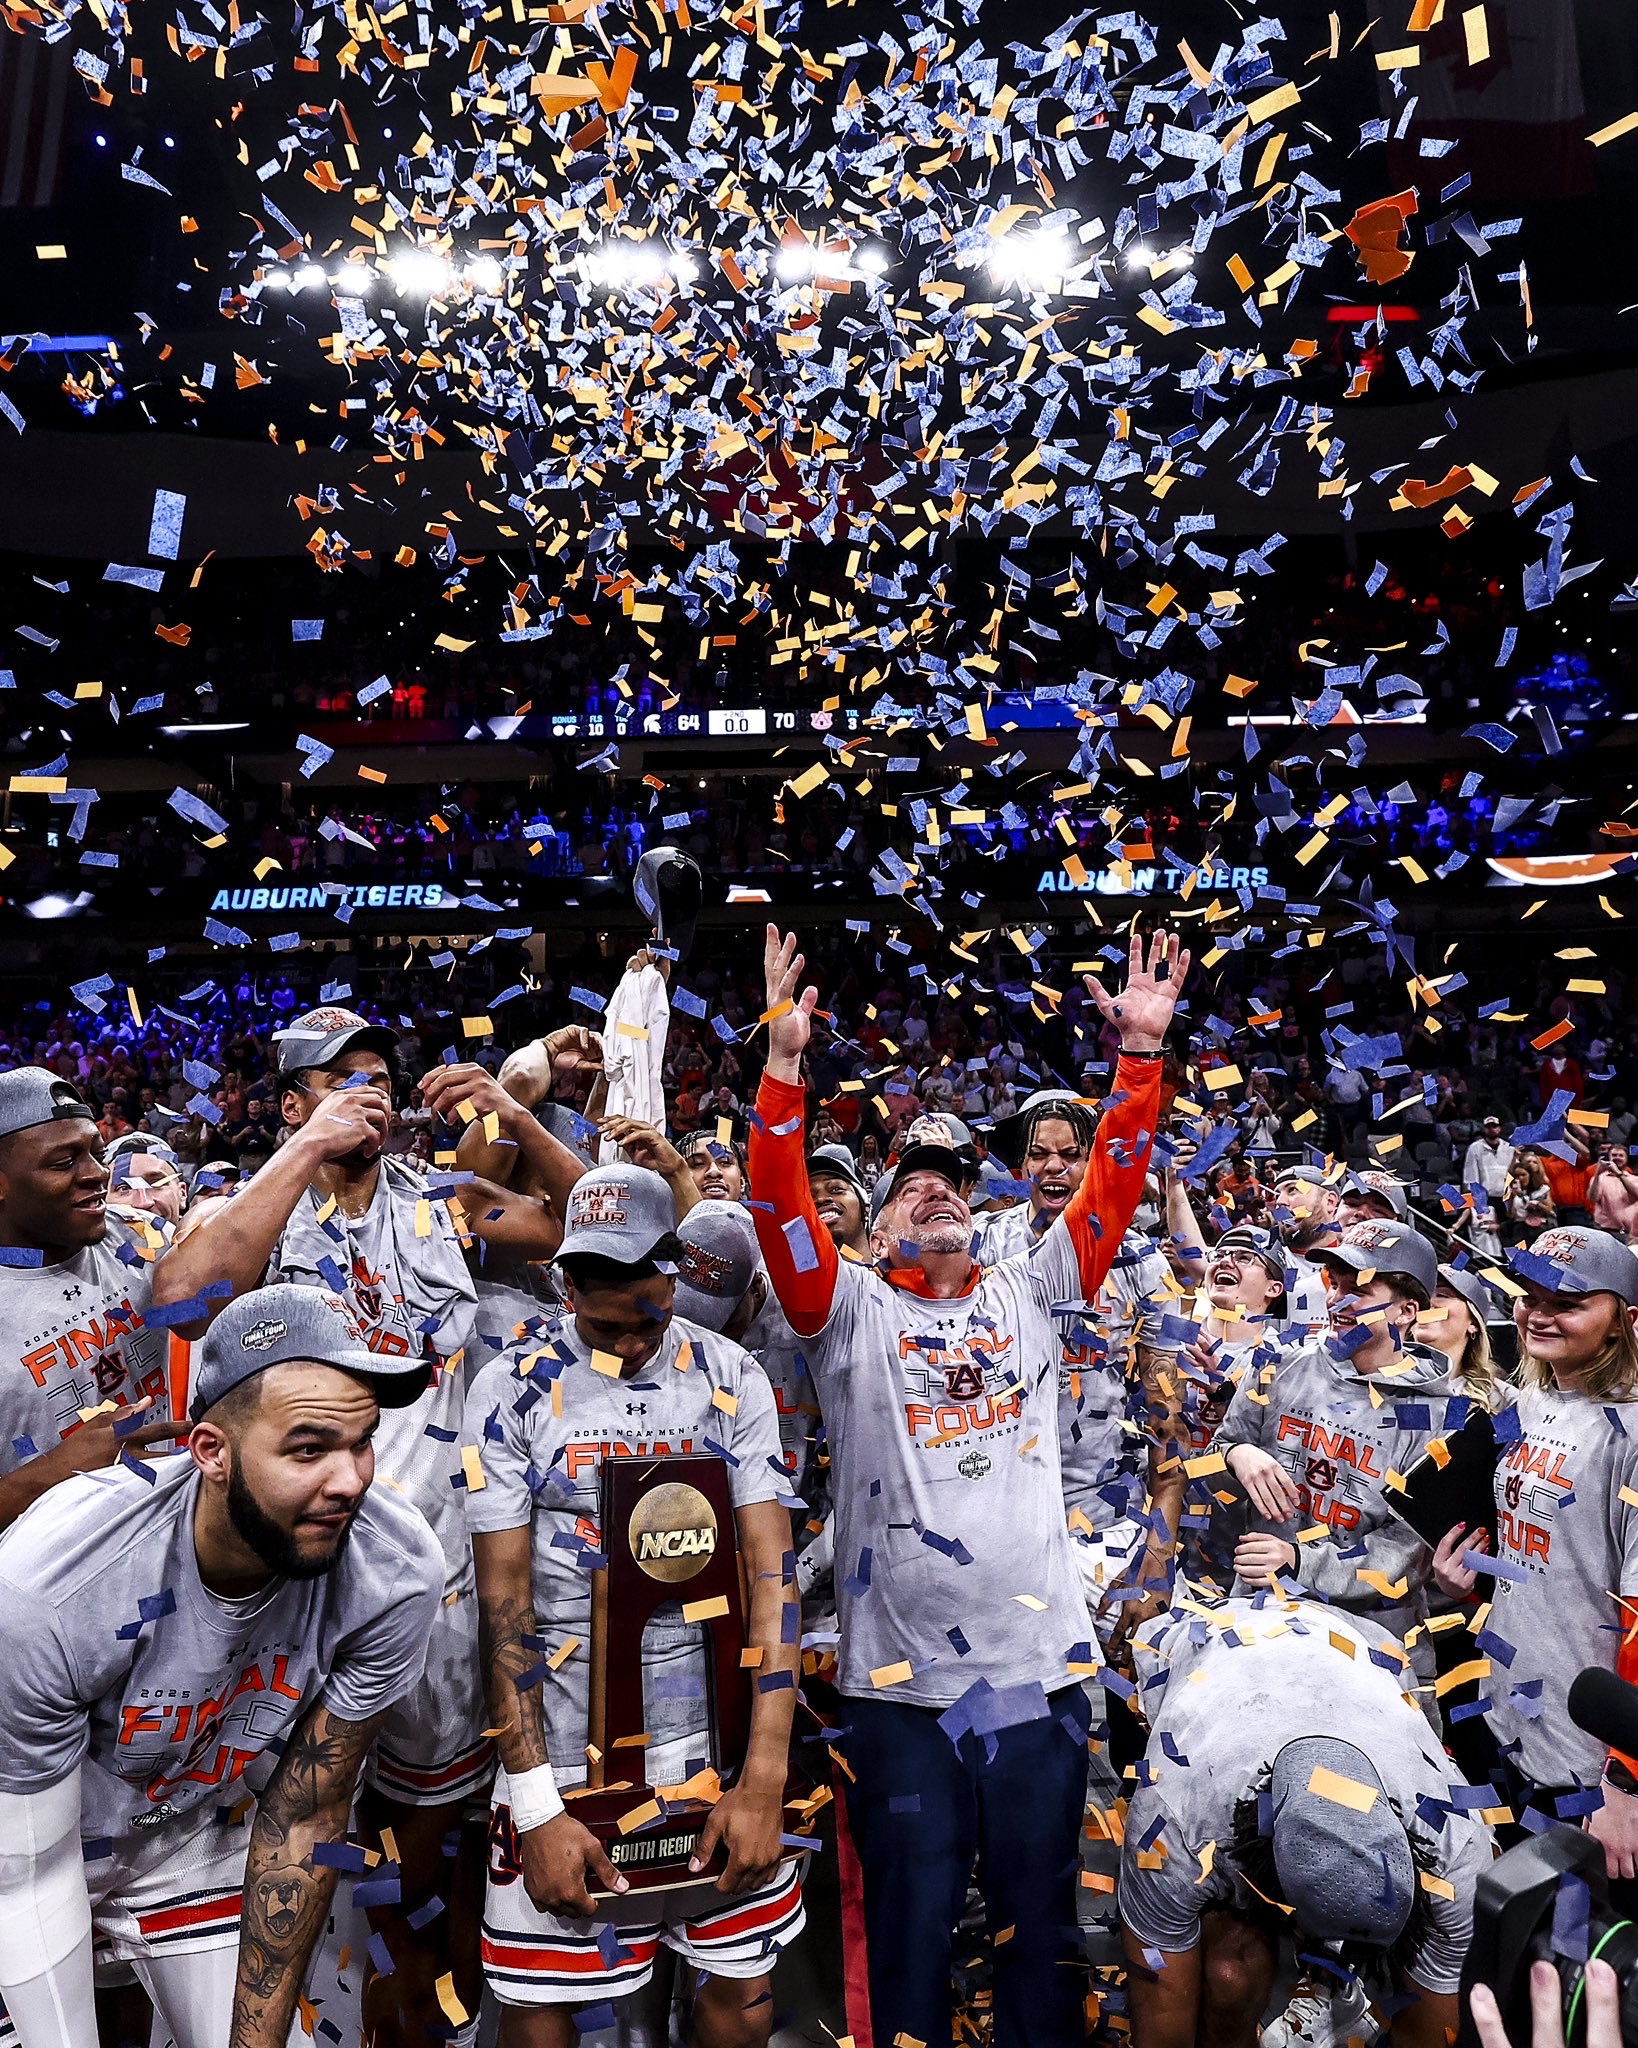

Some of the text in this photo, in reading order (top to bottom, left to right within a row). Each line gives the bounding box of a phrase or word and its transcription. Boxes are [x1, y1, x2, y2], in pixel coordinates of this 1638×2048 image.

[552, 716, 577, 724] BONUS
[589, 715, 603, 723] FLS
[617, 723, 627, 735] 0
[678, 714, 700, 731] 64
[725, 719, 749, 732] 0.0
[773, 712, 795, 729] 70
[847, 718, 857, 730] 3
[588, 723, 604, 736] 10
[1164, 867, 1269, 890] TGERS
[210, 885, 443, 911] AUBURN TIGERS
[571, 1186, 632, 1207] FINAL
[571, 1211, 628, 1231] FOUR
[20, 1298, 146, 1388] FINAL
[23, 1326, 58, 1348] 2025
[245, 1331, 264, 1345] FINAL
[264, 1323, 285, 1337] FOUR
[905, 1391, 1022, 1436] FOUR
[574, 1424, 699, 1438] 2025 NCAA MEN'S
[978, 1424, 1020, 1443] TIGERS
[1277, 1414, 1381, 1478] FINAL
[1283, 1484, 1362, 1532] OUR
[639, 1527, 716, 1560] NCAA
[118, 1653, 301, 1745] FINAL
[140, 1688, 191, 1699] 2025
[611, 1832, 700, 1864] SOUTH REGIO
